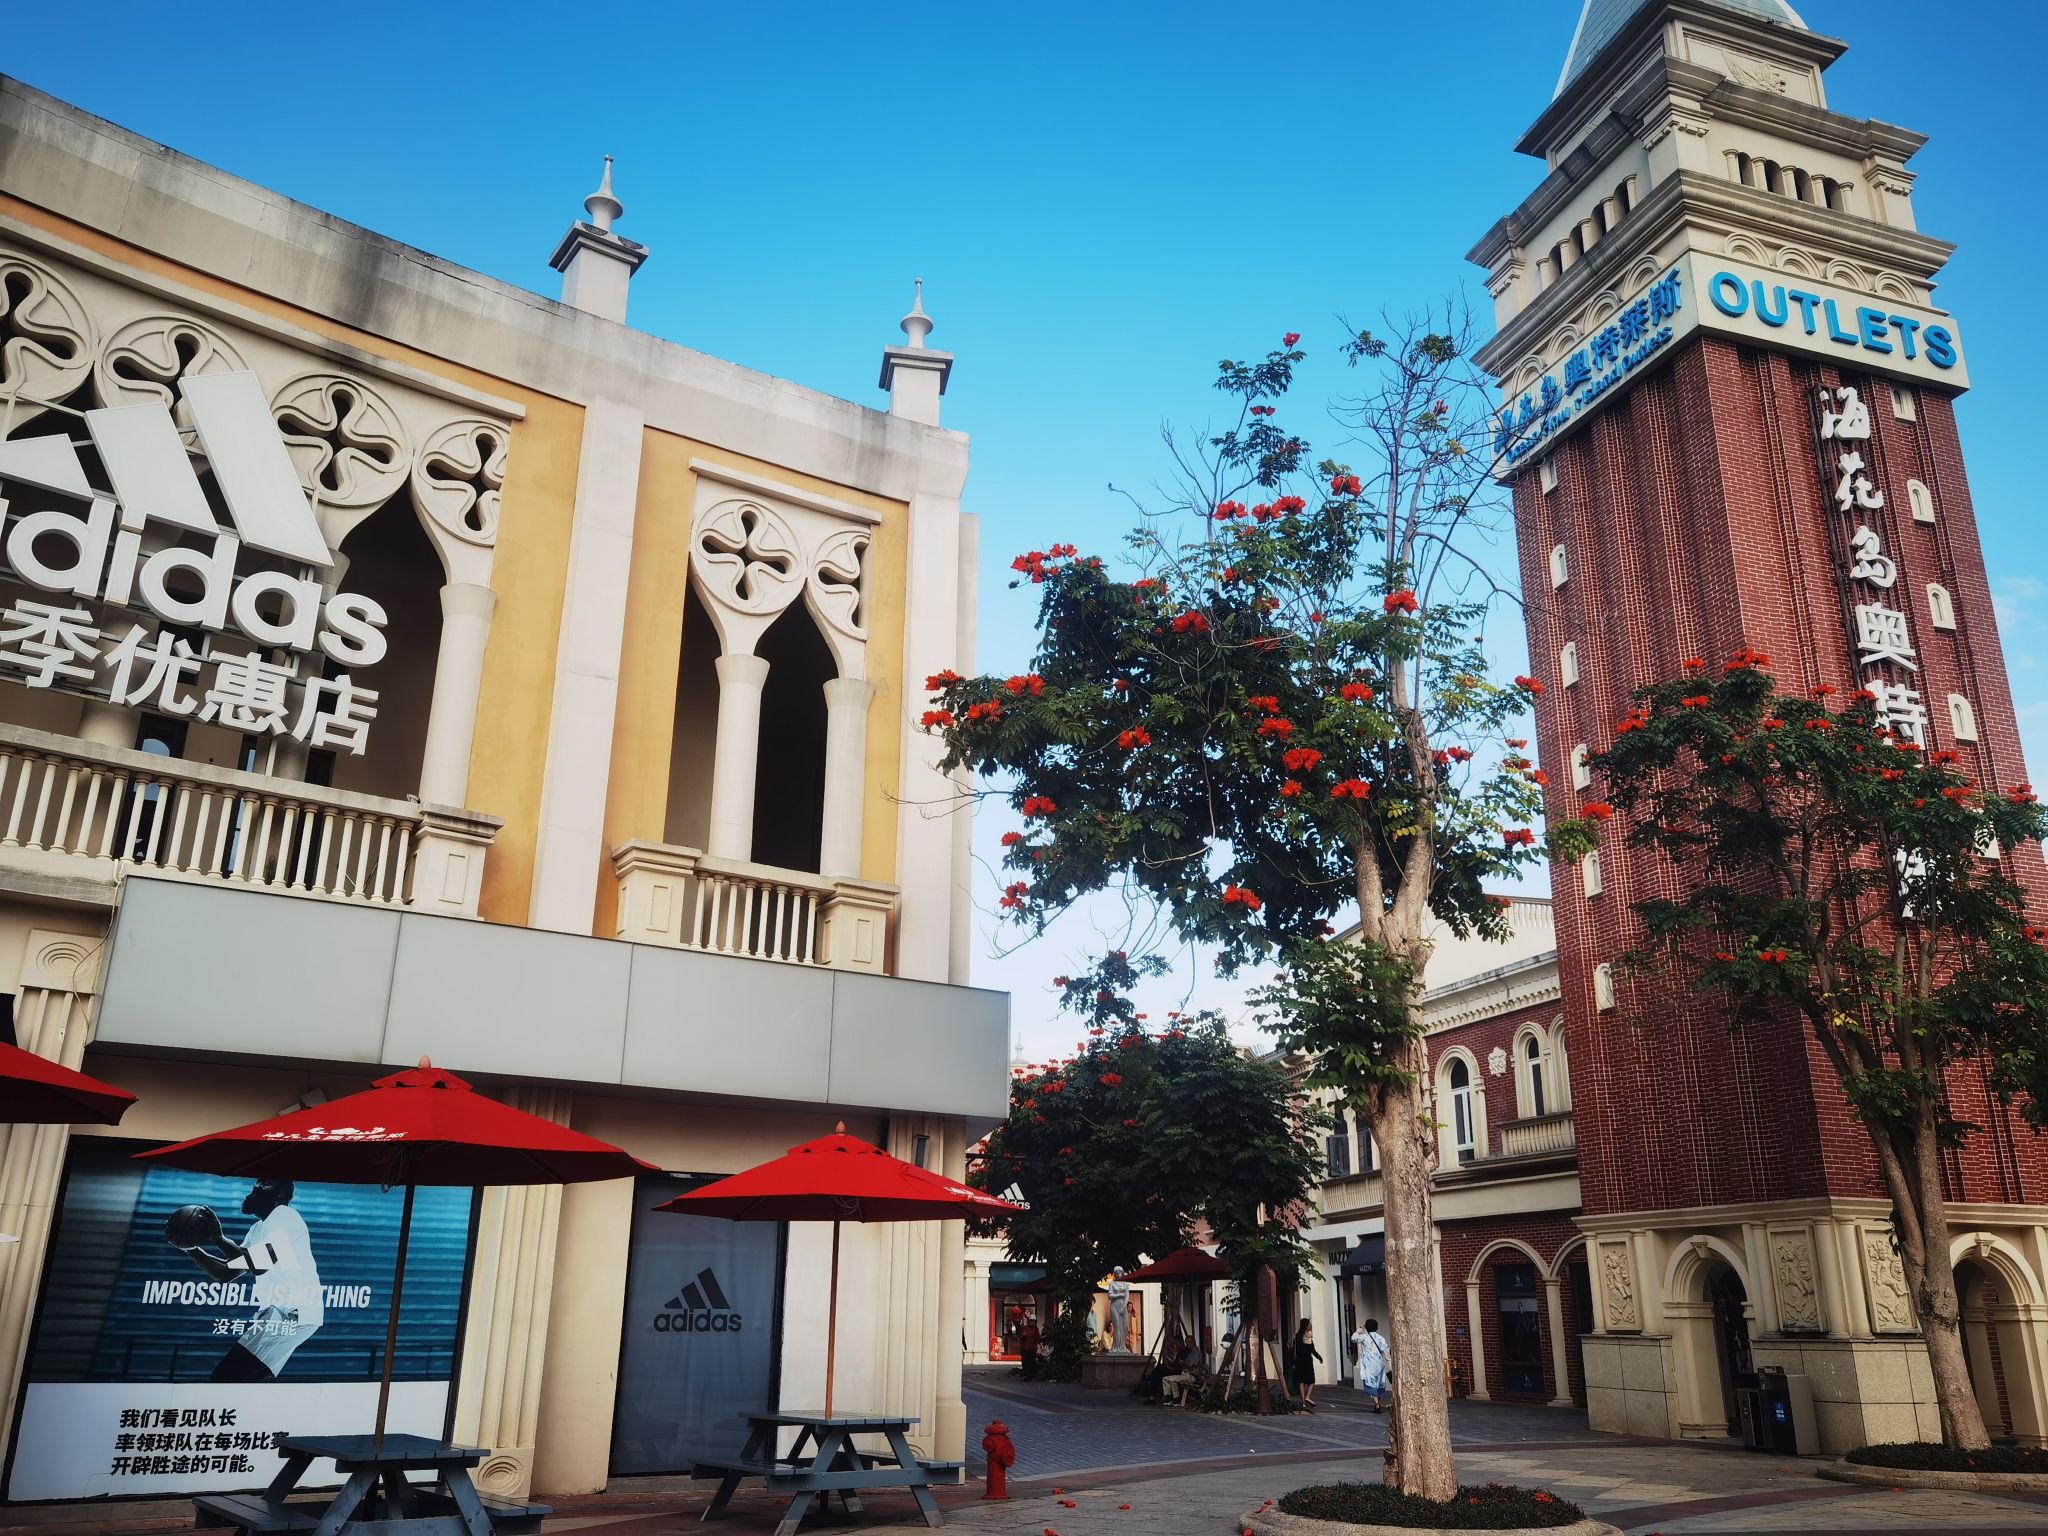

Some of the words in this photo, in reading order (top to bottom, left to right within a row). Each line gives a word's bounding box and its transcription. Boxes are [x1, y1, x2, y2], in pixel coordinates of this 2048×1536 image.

[1708, 270, 1958, 369] OUTLETS
[1494, 267, 1682, 454] 海花岛奥特莱斯
[1581, 362, 1623, 405] Island
[1622, 327, 1673, 373] Outlets
[0, 496, 389, 668] didas
[0, 598, 380, 757] 季优惠店
[1820, 386, 1956, 918] 海花岛奥特
[1328, 1250, 1353, 1266] HAZZY
[142, 1280, 263, 1307] IMPOSSIBLE
[212, 1318, 299, 1336] 没有不可能
[653, 1308, 742, 1332] adidas
[119, 1408, 237, 1429] 我们看见队长
[110, 1454, 255, 1476] 开辟胜途的可能。
